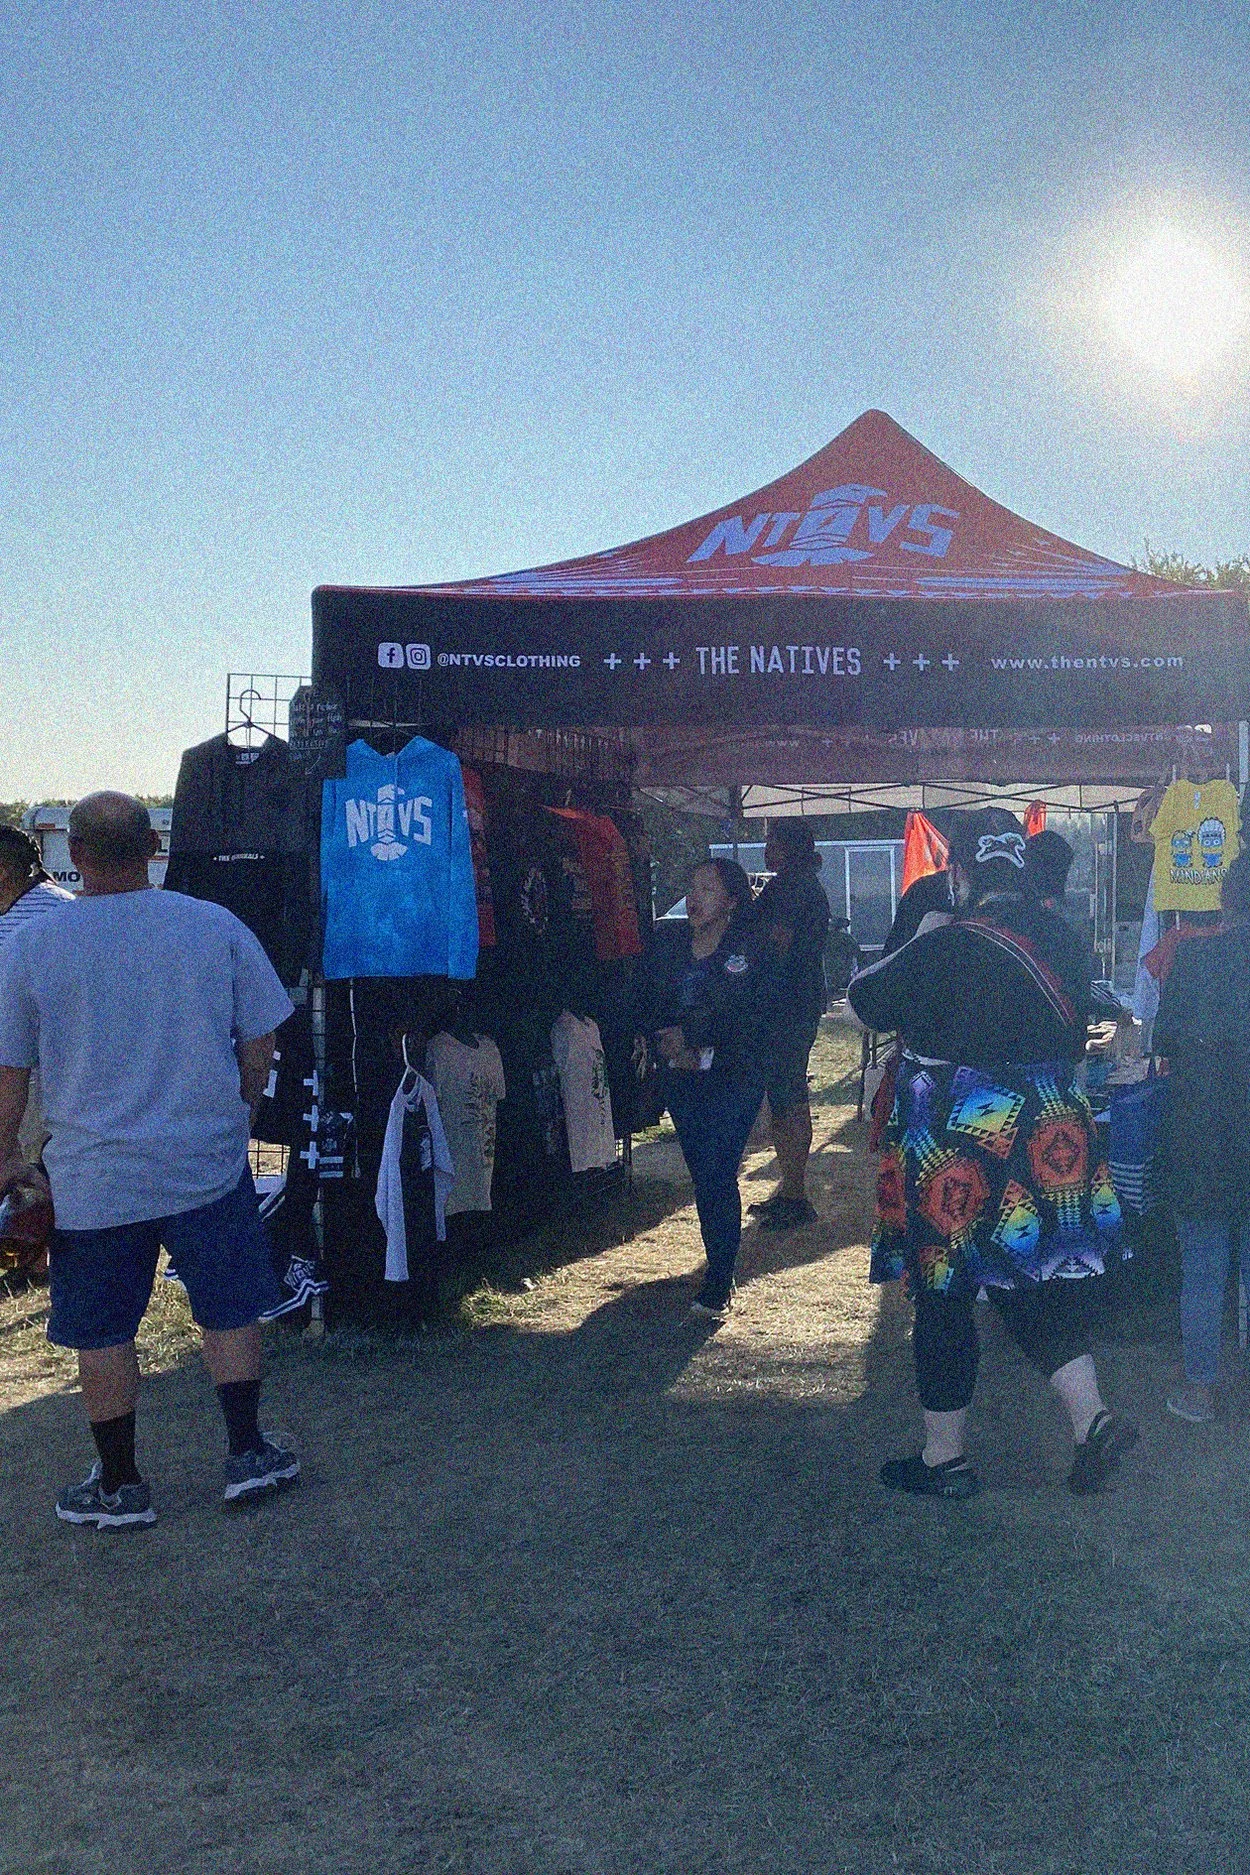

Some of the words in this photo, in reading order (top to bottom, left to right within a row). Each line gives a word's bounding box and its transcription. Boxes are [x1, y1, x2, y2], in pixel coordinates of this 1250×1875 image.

[437, 653, 581, 668] @NTVSCLOTHING
[696, 645, 740, 675] THE
[749, 646, 862, 676] NATIVES
[990, 653, 1185, 669] www.thentvs.com
